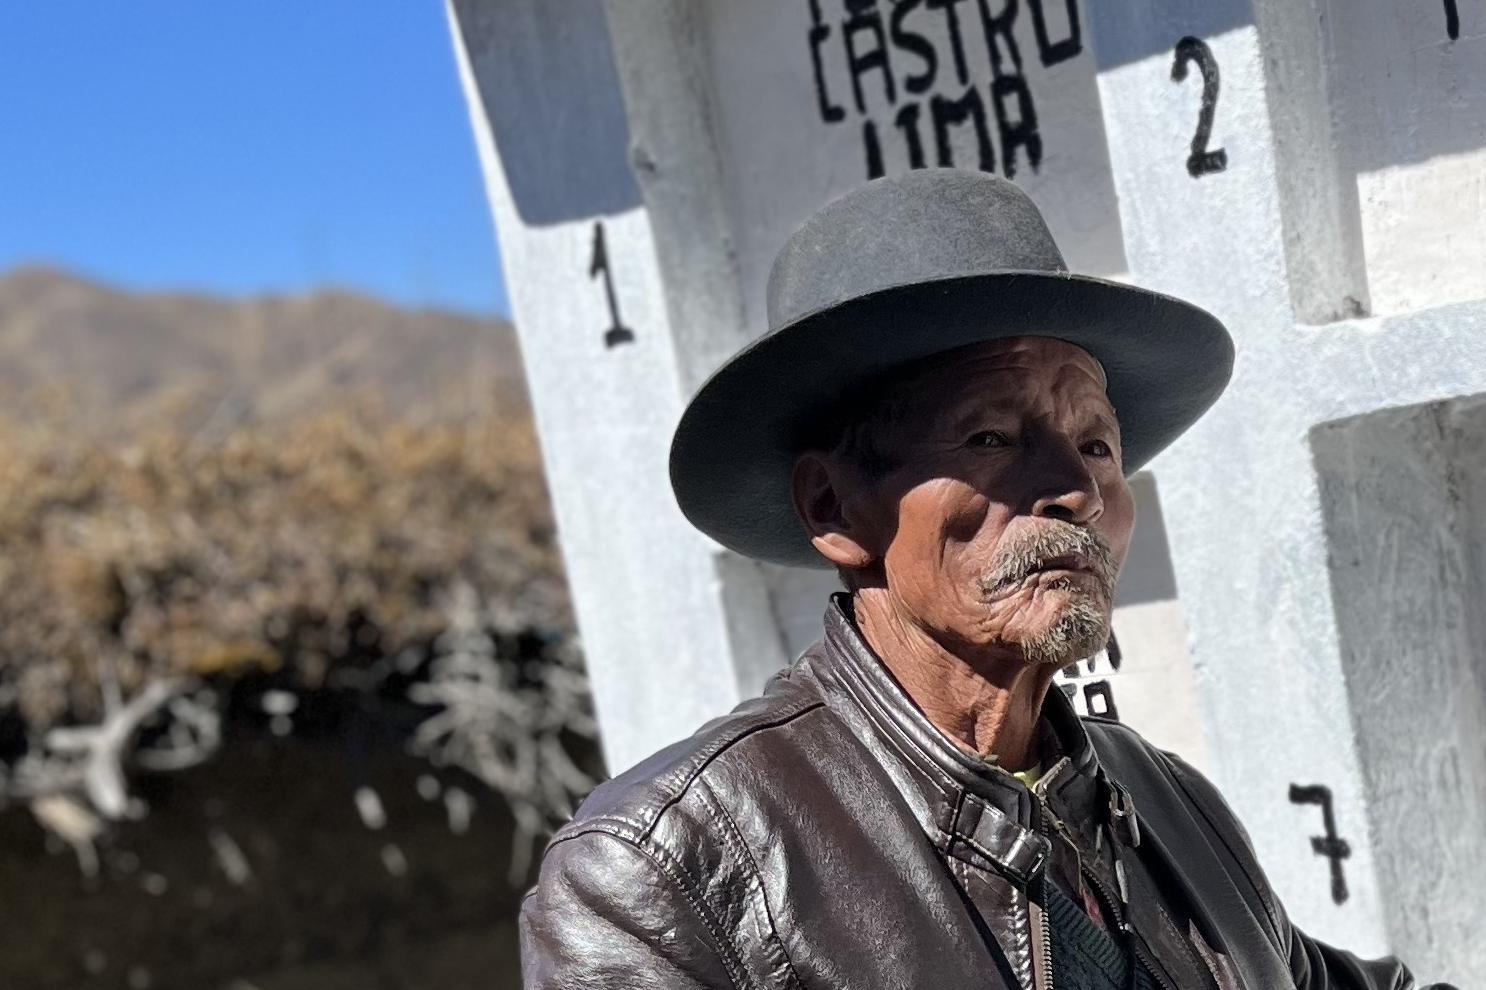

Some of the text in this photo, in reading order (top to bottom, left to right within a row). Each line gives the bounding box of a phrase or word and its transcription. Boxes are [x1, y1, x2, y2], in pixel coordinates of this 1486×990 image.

[1170, 35, 1228, 179] 2
[589, 220, 635, 349] 1
[1289, 783, 1352, 905] 7
